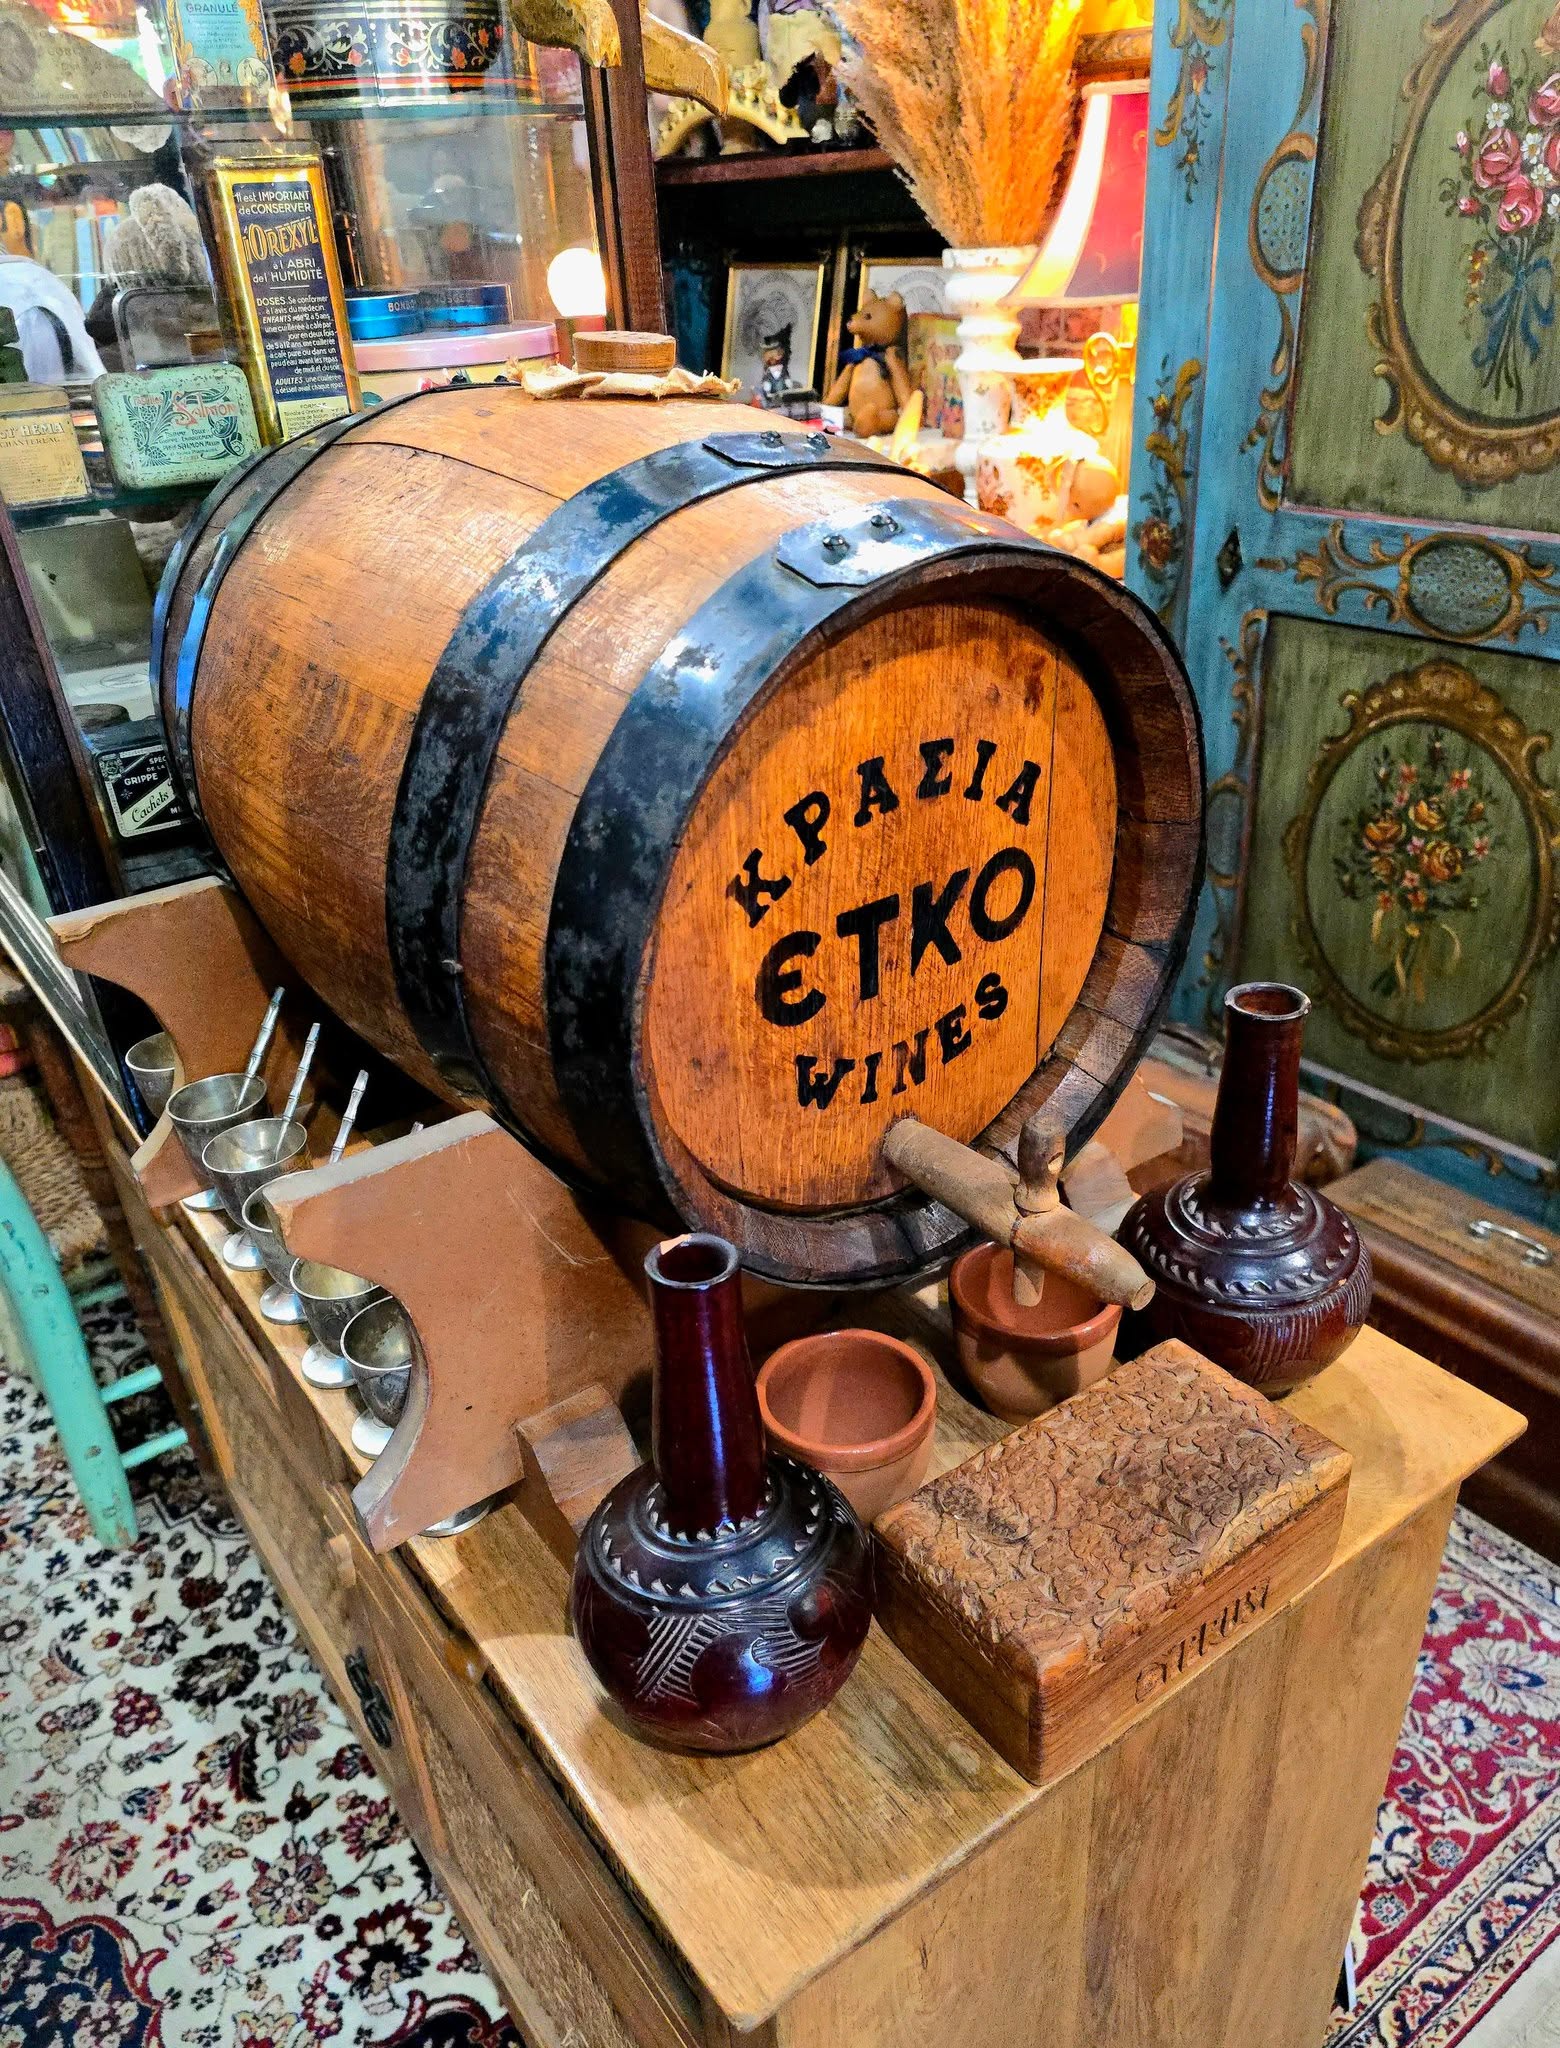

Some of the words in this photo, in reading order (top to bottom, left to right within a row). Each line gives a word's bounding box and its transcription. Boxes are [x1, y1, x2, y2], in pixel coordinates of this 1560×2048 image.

[186, 1, 239, 14] GRANULÉ
[243, 193, 257, 203] est
[258, 190, 310, 202] IMPORTANT
[238, 206, 251, 215] de
[250, 202, 312, 214] CONSERVER
[252, 274, 265, 283] de
[297, 295, 329, 304] conformer
[311, 347, 327, 355] dans
[177, 441, 205, 450] SALMON
[124, 772, 159, 786] GRIPPE
[131, 789, 170, 823] Cachets
[754, 846, 1036, 1027] ETKO
[795, 972, 1009, 1111] WINES
